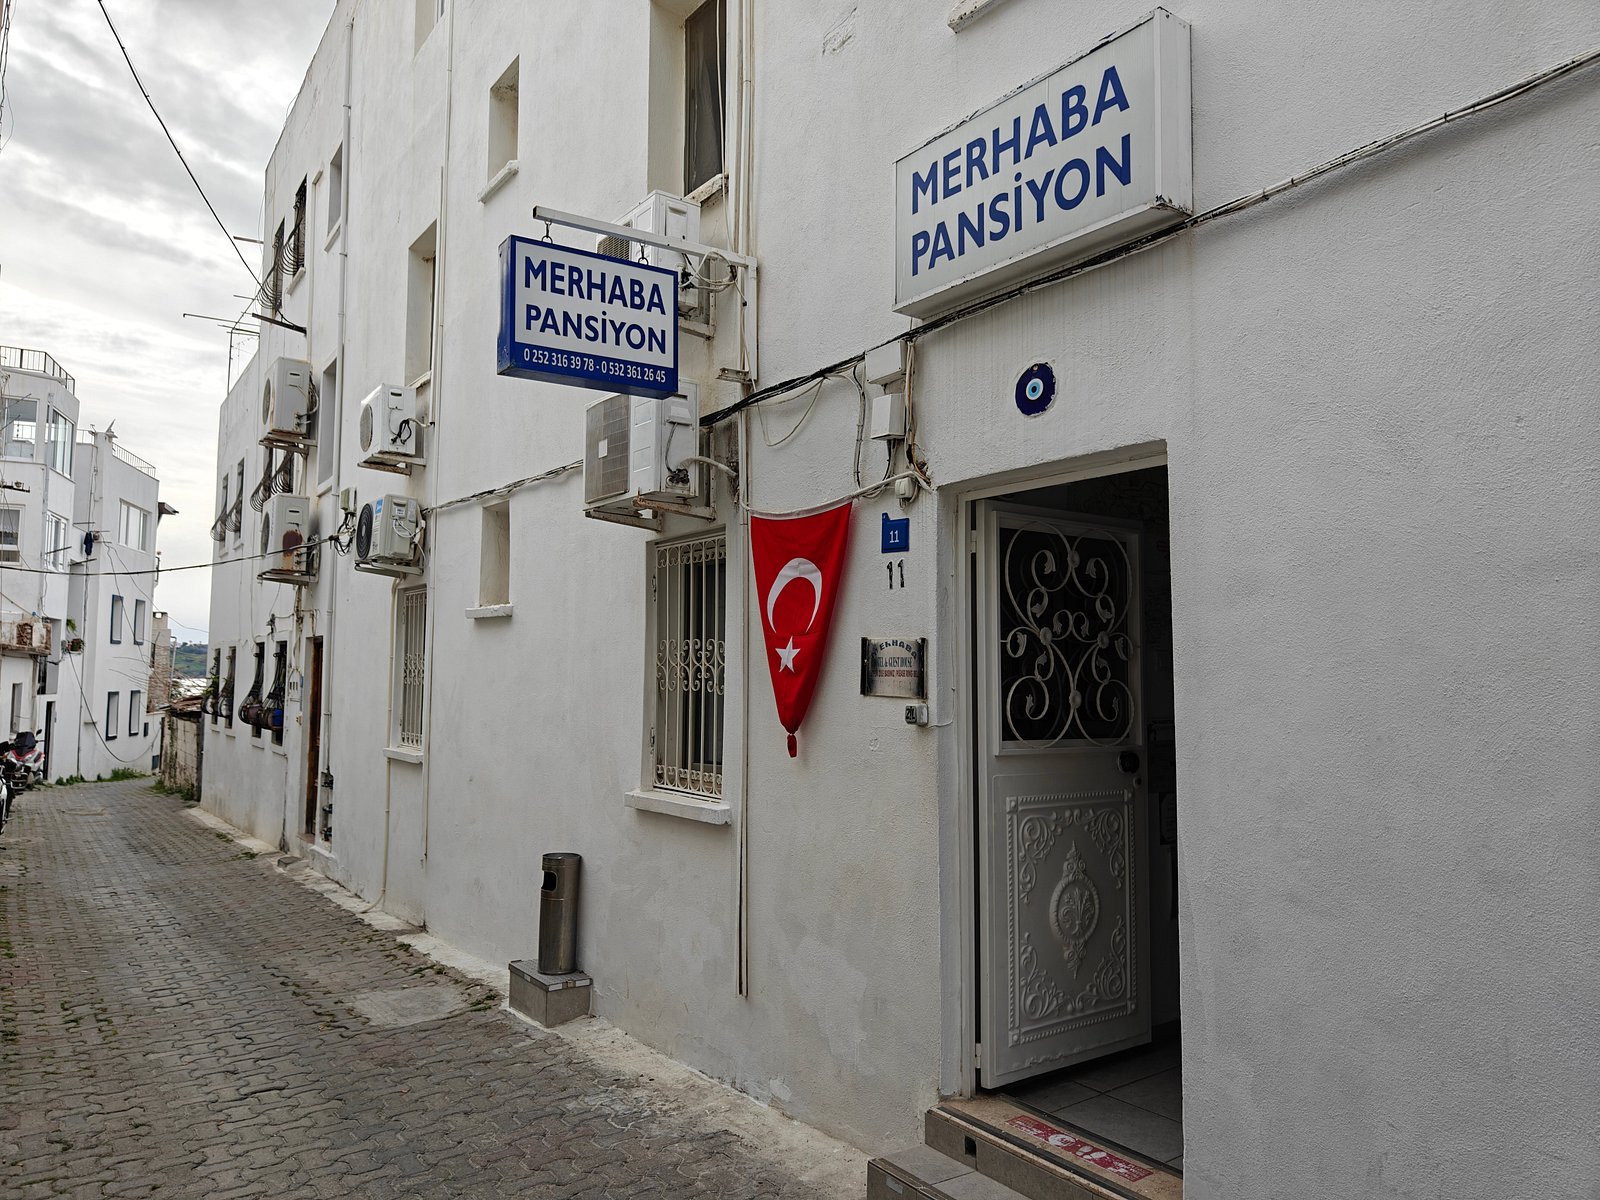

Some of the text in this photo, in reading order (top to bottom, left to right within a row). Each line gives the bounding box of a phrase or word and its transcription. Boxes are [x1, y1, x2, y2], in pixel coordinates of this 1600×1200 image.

[911, 64, 1131, 216] MERHABA
[911, 133, 1132, 277] PANSİYON
[524, 255, 667, 316] MERHABA
[525, 303, 666, 355] PANSİYON
[523, 348, 530, 361] 0
[532, 349, 549, 365] 252
[551, 352, 568, 368] 316
[570, 355, 581, 369] 39
[583, 357, 594, 372] 78
[601, 360, 608, 374] 0
[609, 361, 625, 377] 532
[626, 364, 642, 379] 361
[643, 367, 654, 381] 26
[655, 370, 666, 383] 45
[889, 529, 900, 544] 11
[886, 559, 905, 590] 11
